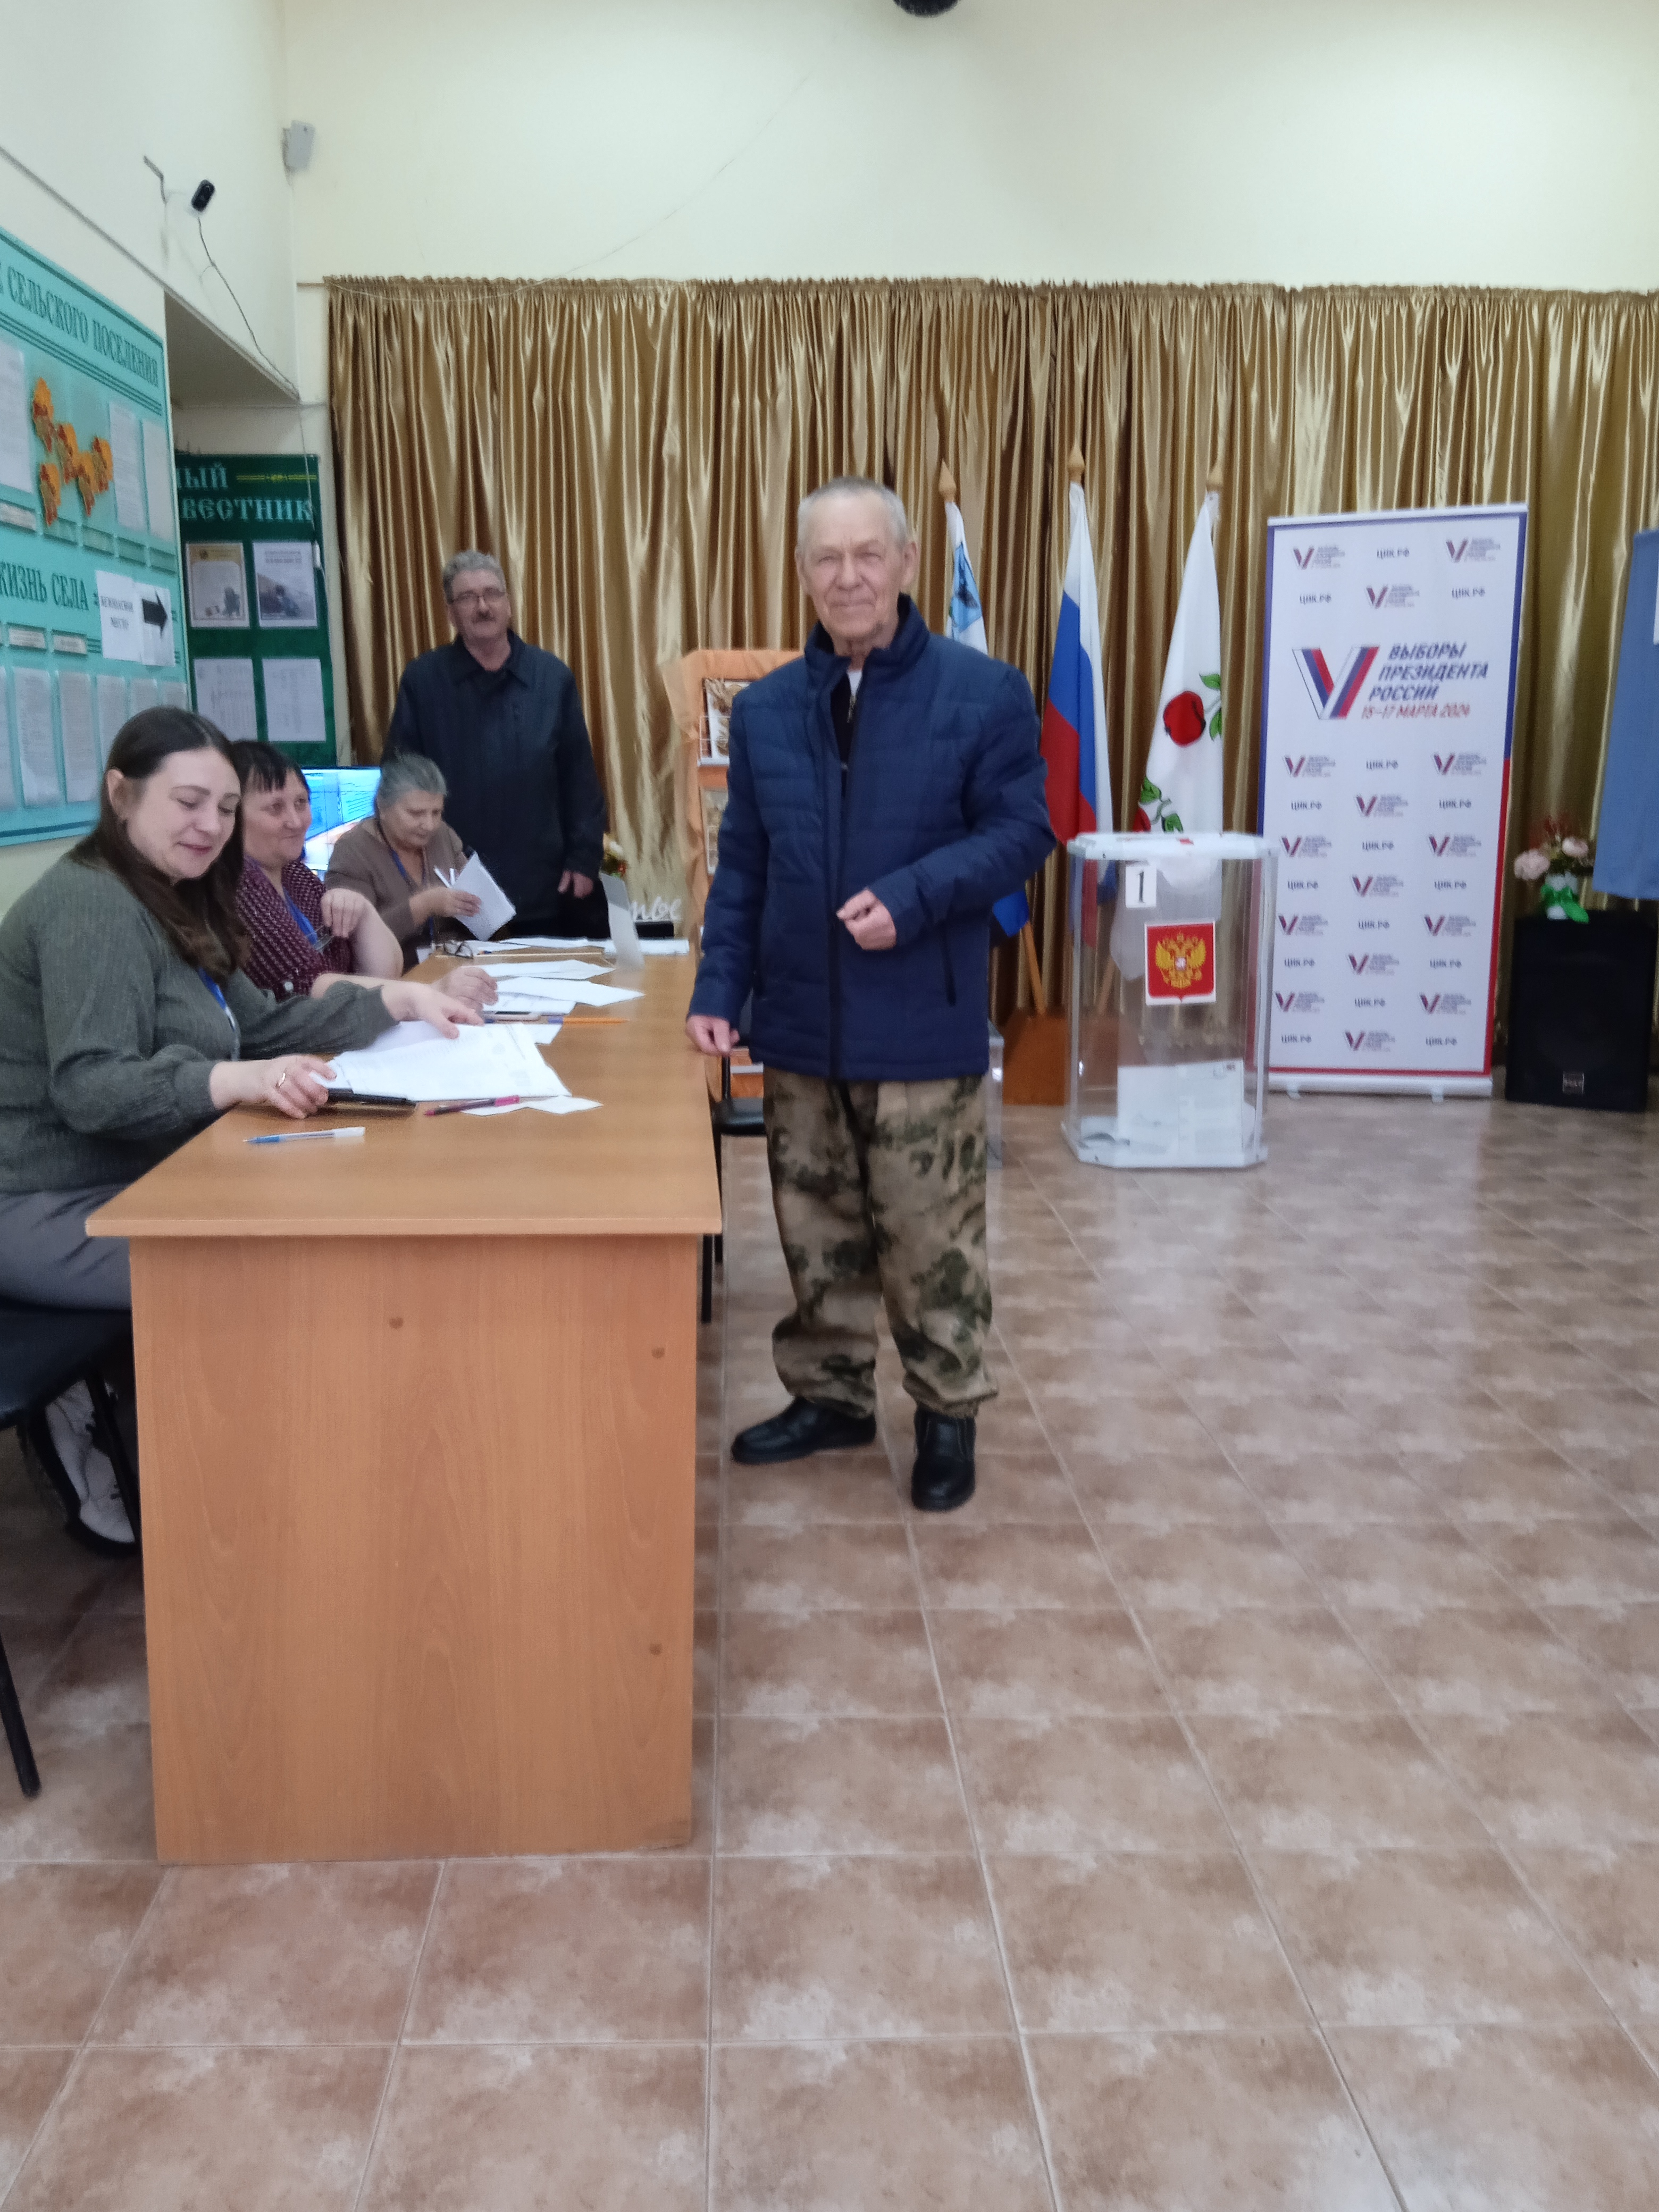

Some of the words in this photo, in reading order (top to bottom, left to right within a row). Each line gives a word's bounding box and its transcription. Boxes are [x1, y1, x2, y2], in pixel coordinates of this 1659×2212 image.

[7, 265, 89, 343] СЕЛЬСКОГО
[92, 319, 158, 388] ПОСЕЛЕНИЯ
[52, 573, 89, 611] СЕЛА
[1388, 642, 1468, 660] ВЫБОРЫ
[1378, 662, 1489, 682] ПРЕЗИДЕНТА
[1368, 684, 1439, 701] РОССИИ
[1396, 703, 1438, 718] МАРТА
[1439, 702, 1471, 718] 2024
[1136, 870, 1145, 904] 1
